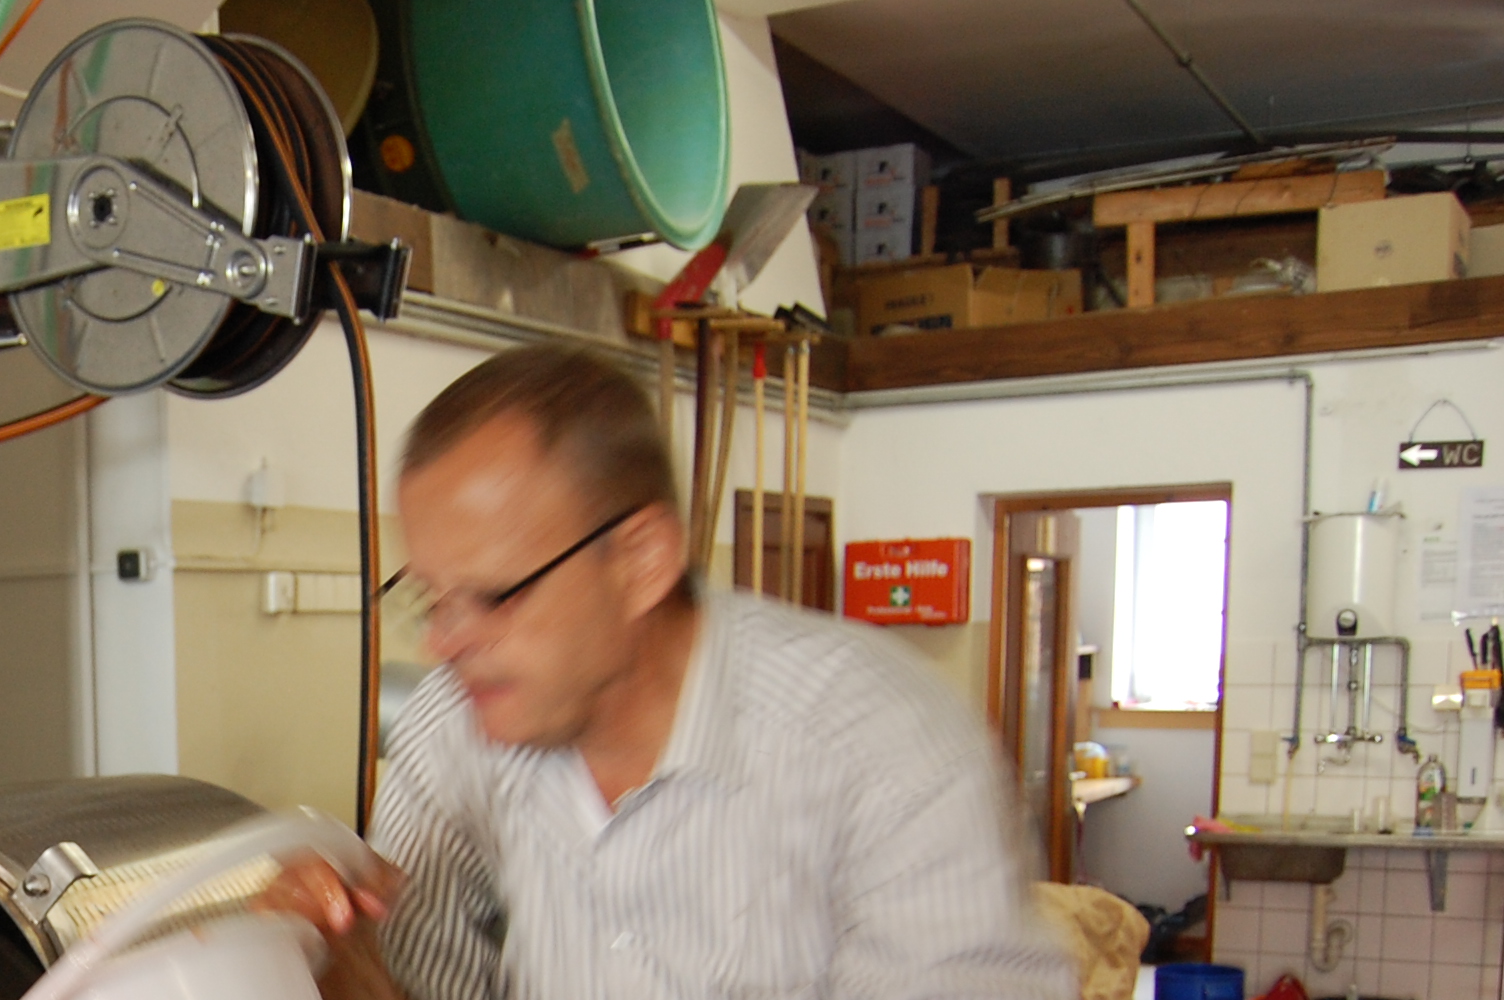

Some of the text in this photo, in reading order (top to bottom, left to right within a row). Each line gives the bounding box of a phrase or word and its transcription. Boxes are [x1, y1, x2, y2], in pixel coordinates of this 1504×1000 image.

[1442, 443, 1481, 466] WC
[853, 559, 949, 580] Erste Hilfe
